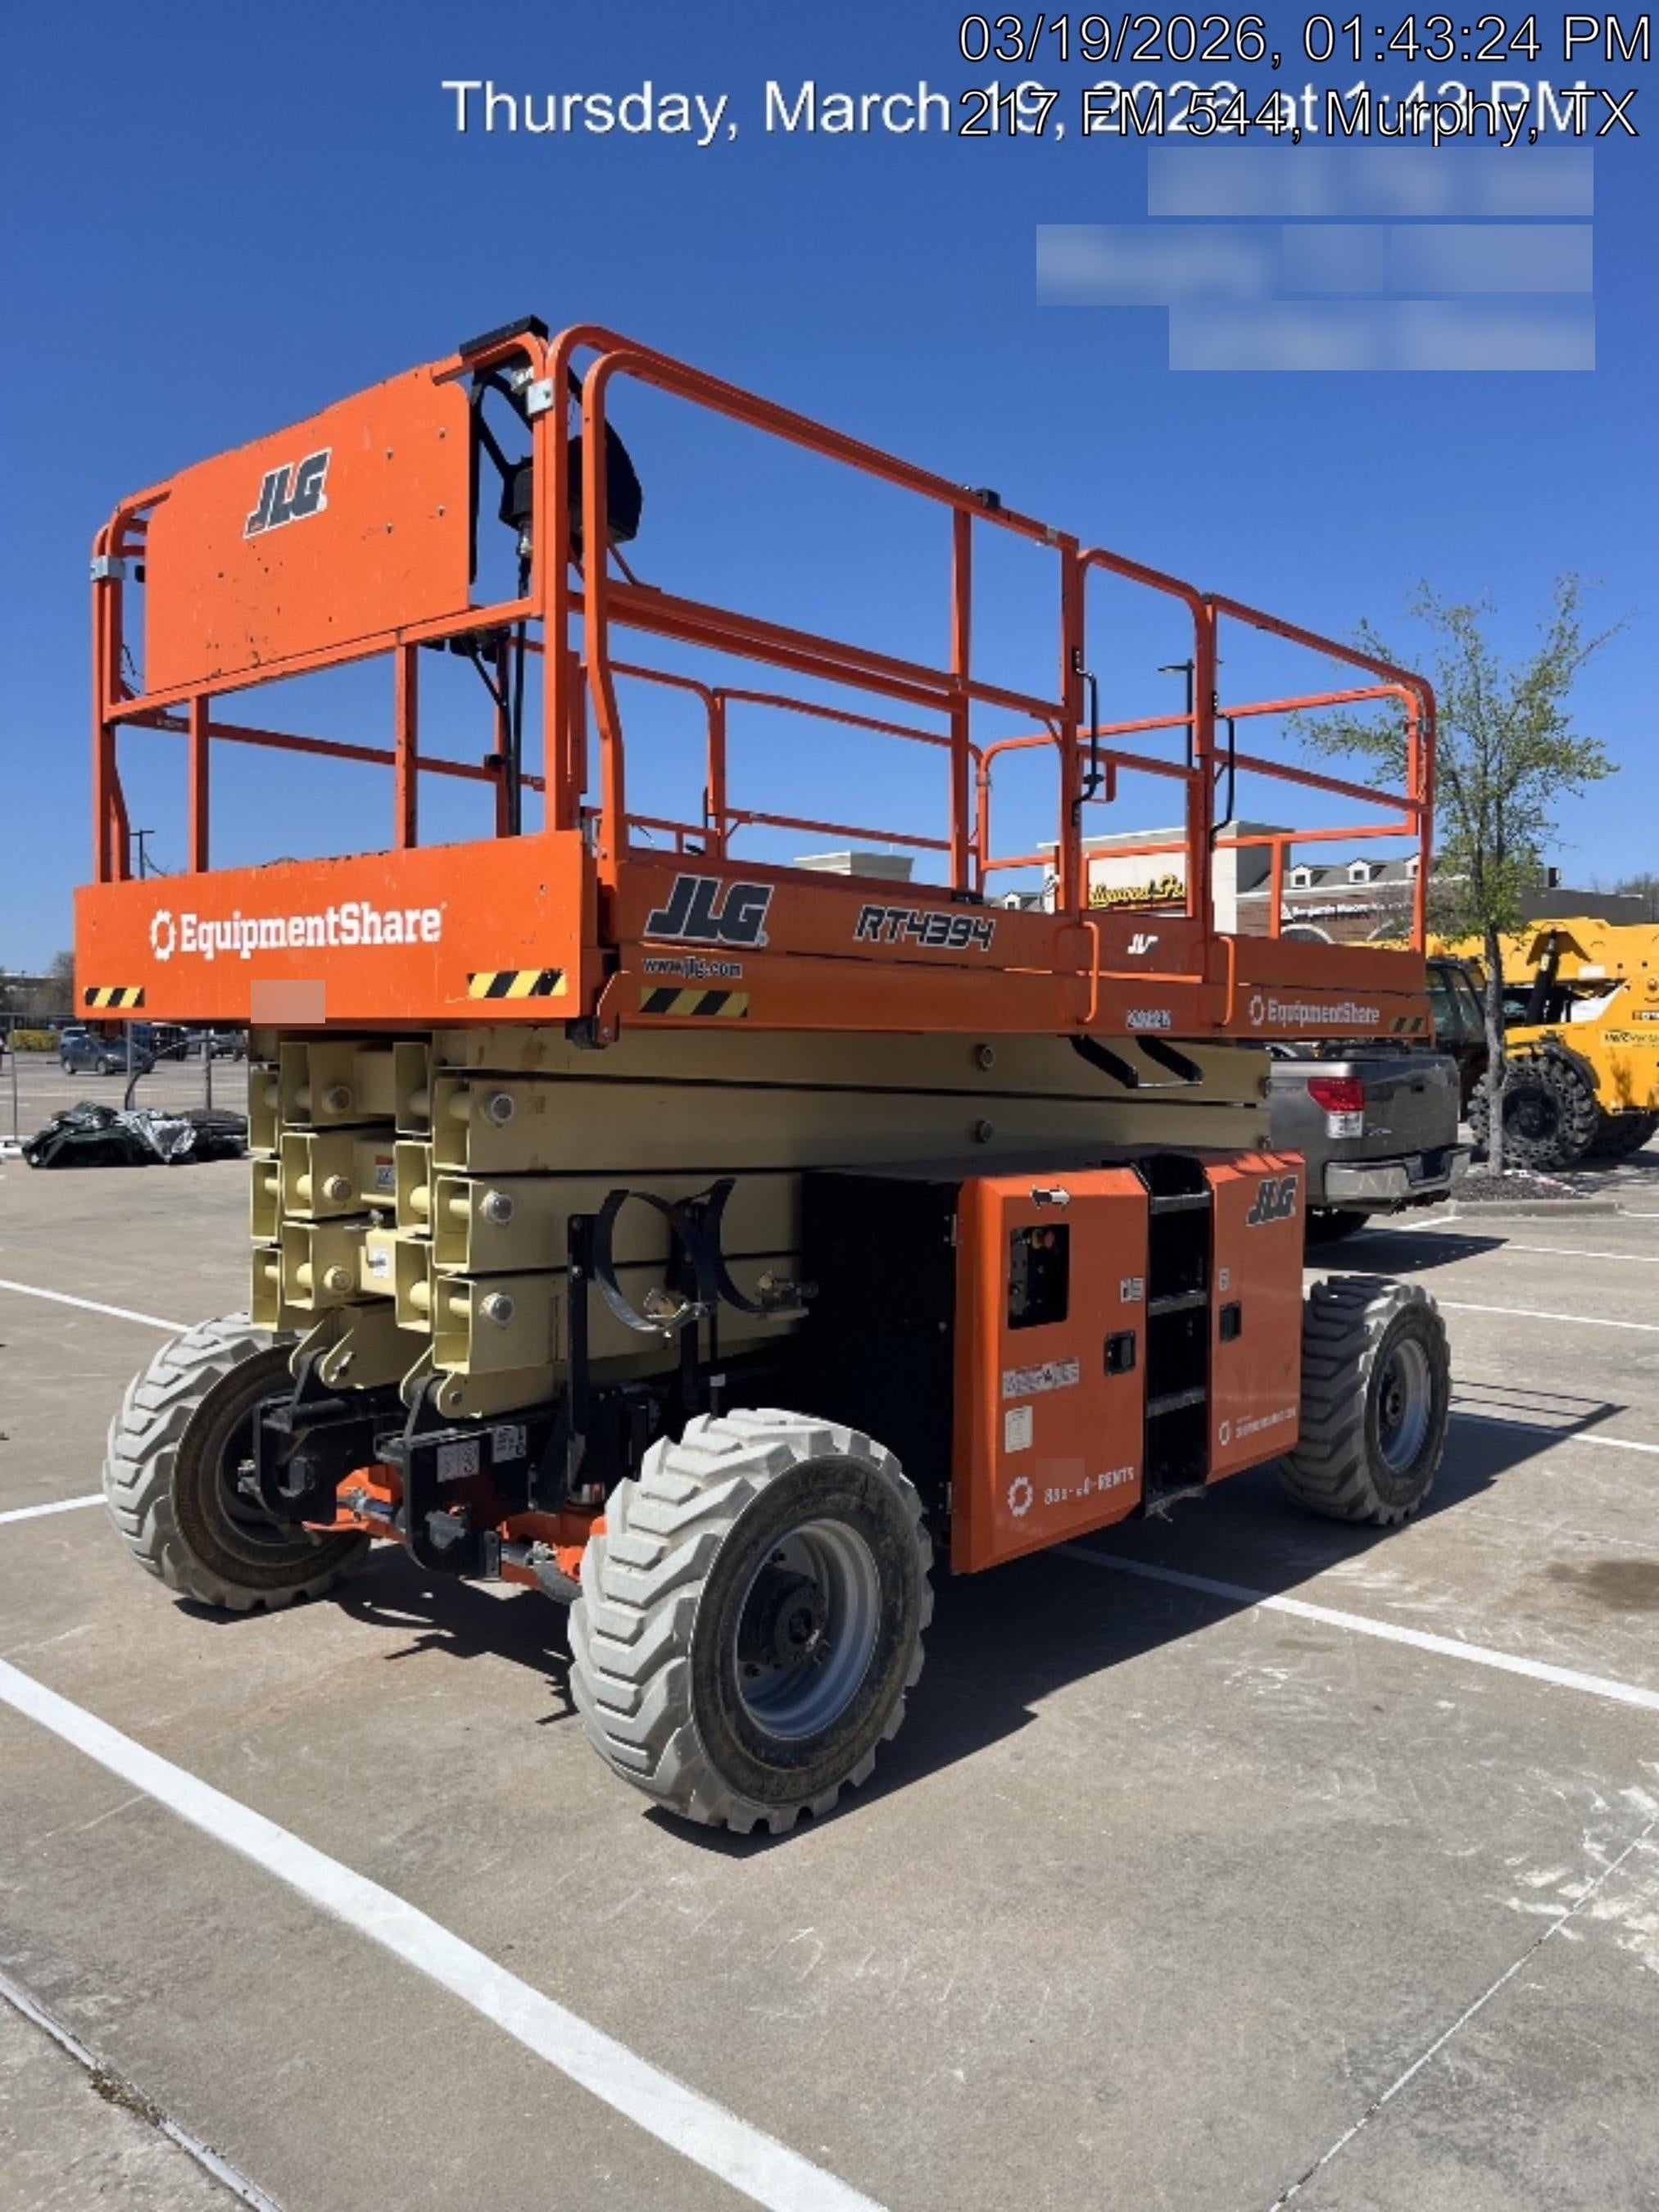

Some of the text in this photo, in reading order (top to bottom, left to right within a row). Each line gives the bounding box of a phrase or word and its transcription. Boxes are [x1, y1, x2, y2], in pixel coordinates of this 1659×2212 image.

[243, 446, 332, 539] JLG
[180, 901, 442, 961] EquipmentShare
[644, 873, 774, 947] JLG
[851, 904, 996, 952] RT4394
[643, 955, 742, 980] www.jlg.com
[1267, 998, 1380, 1028] EquipmentShare
[1245, 1174, 1298, 1227] JLG
